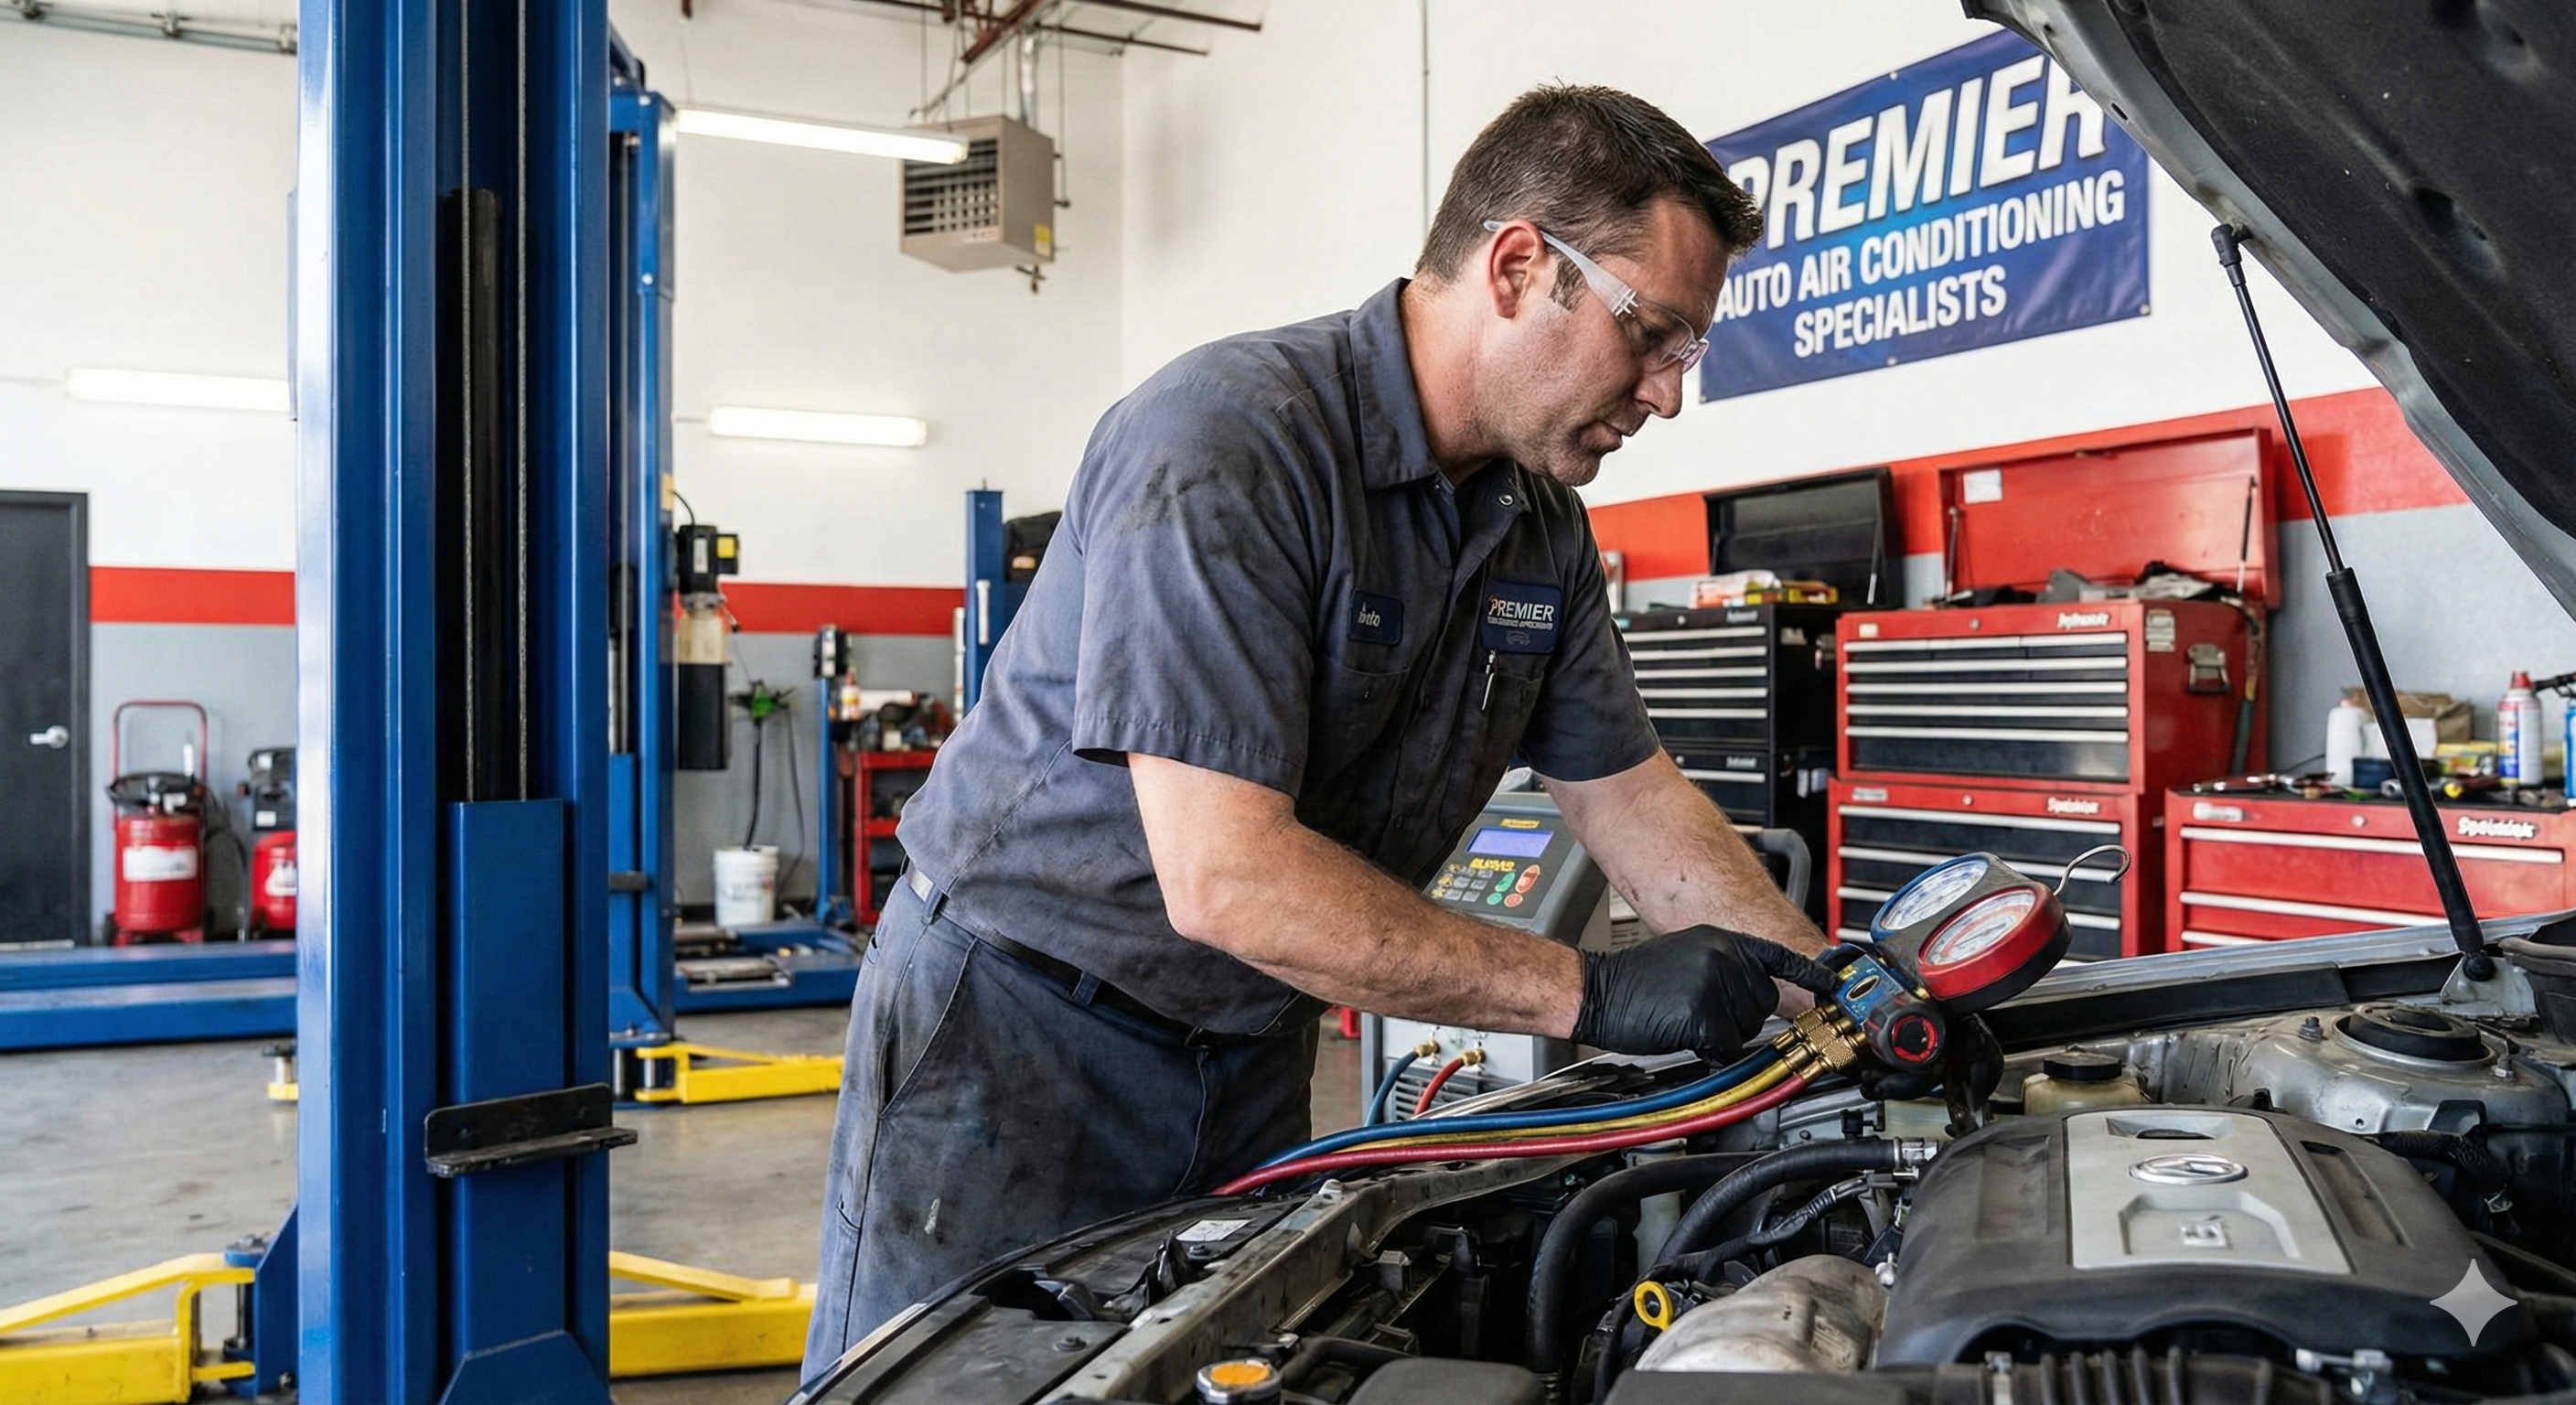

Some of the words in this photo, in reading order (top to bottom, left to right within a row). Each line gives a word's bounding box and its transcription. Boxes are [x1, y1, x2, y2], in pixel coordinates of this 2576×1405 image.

[1713, 262, 1792, 324] AUTO
[1798, 245, 1852, 302] AIR
[1860, 169, 2125, 285] CONDITIONING
[1794, 264, 2007, 359] SPECIALISTS
[1488, 598, 1554, 622] PREMIER
